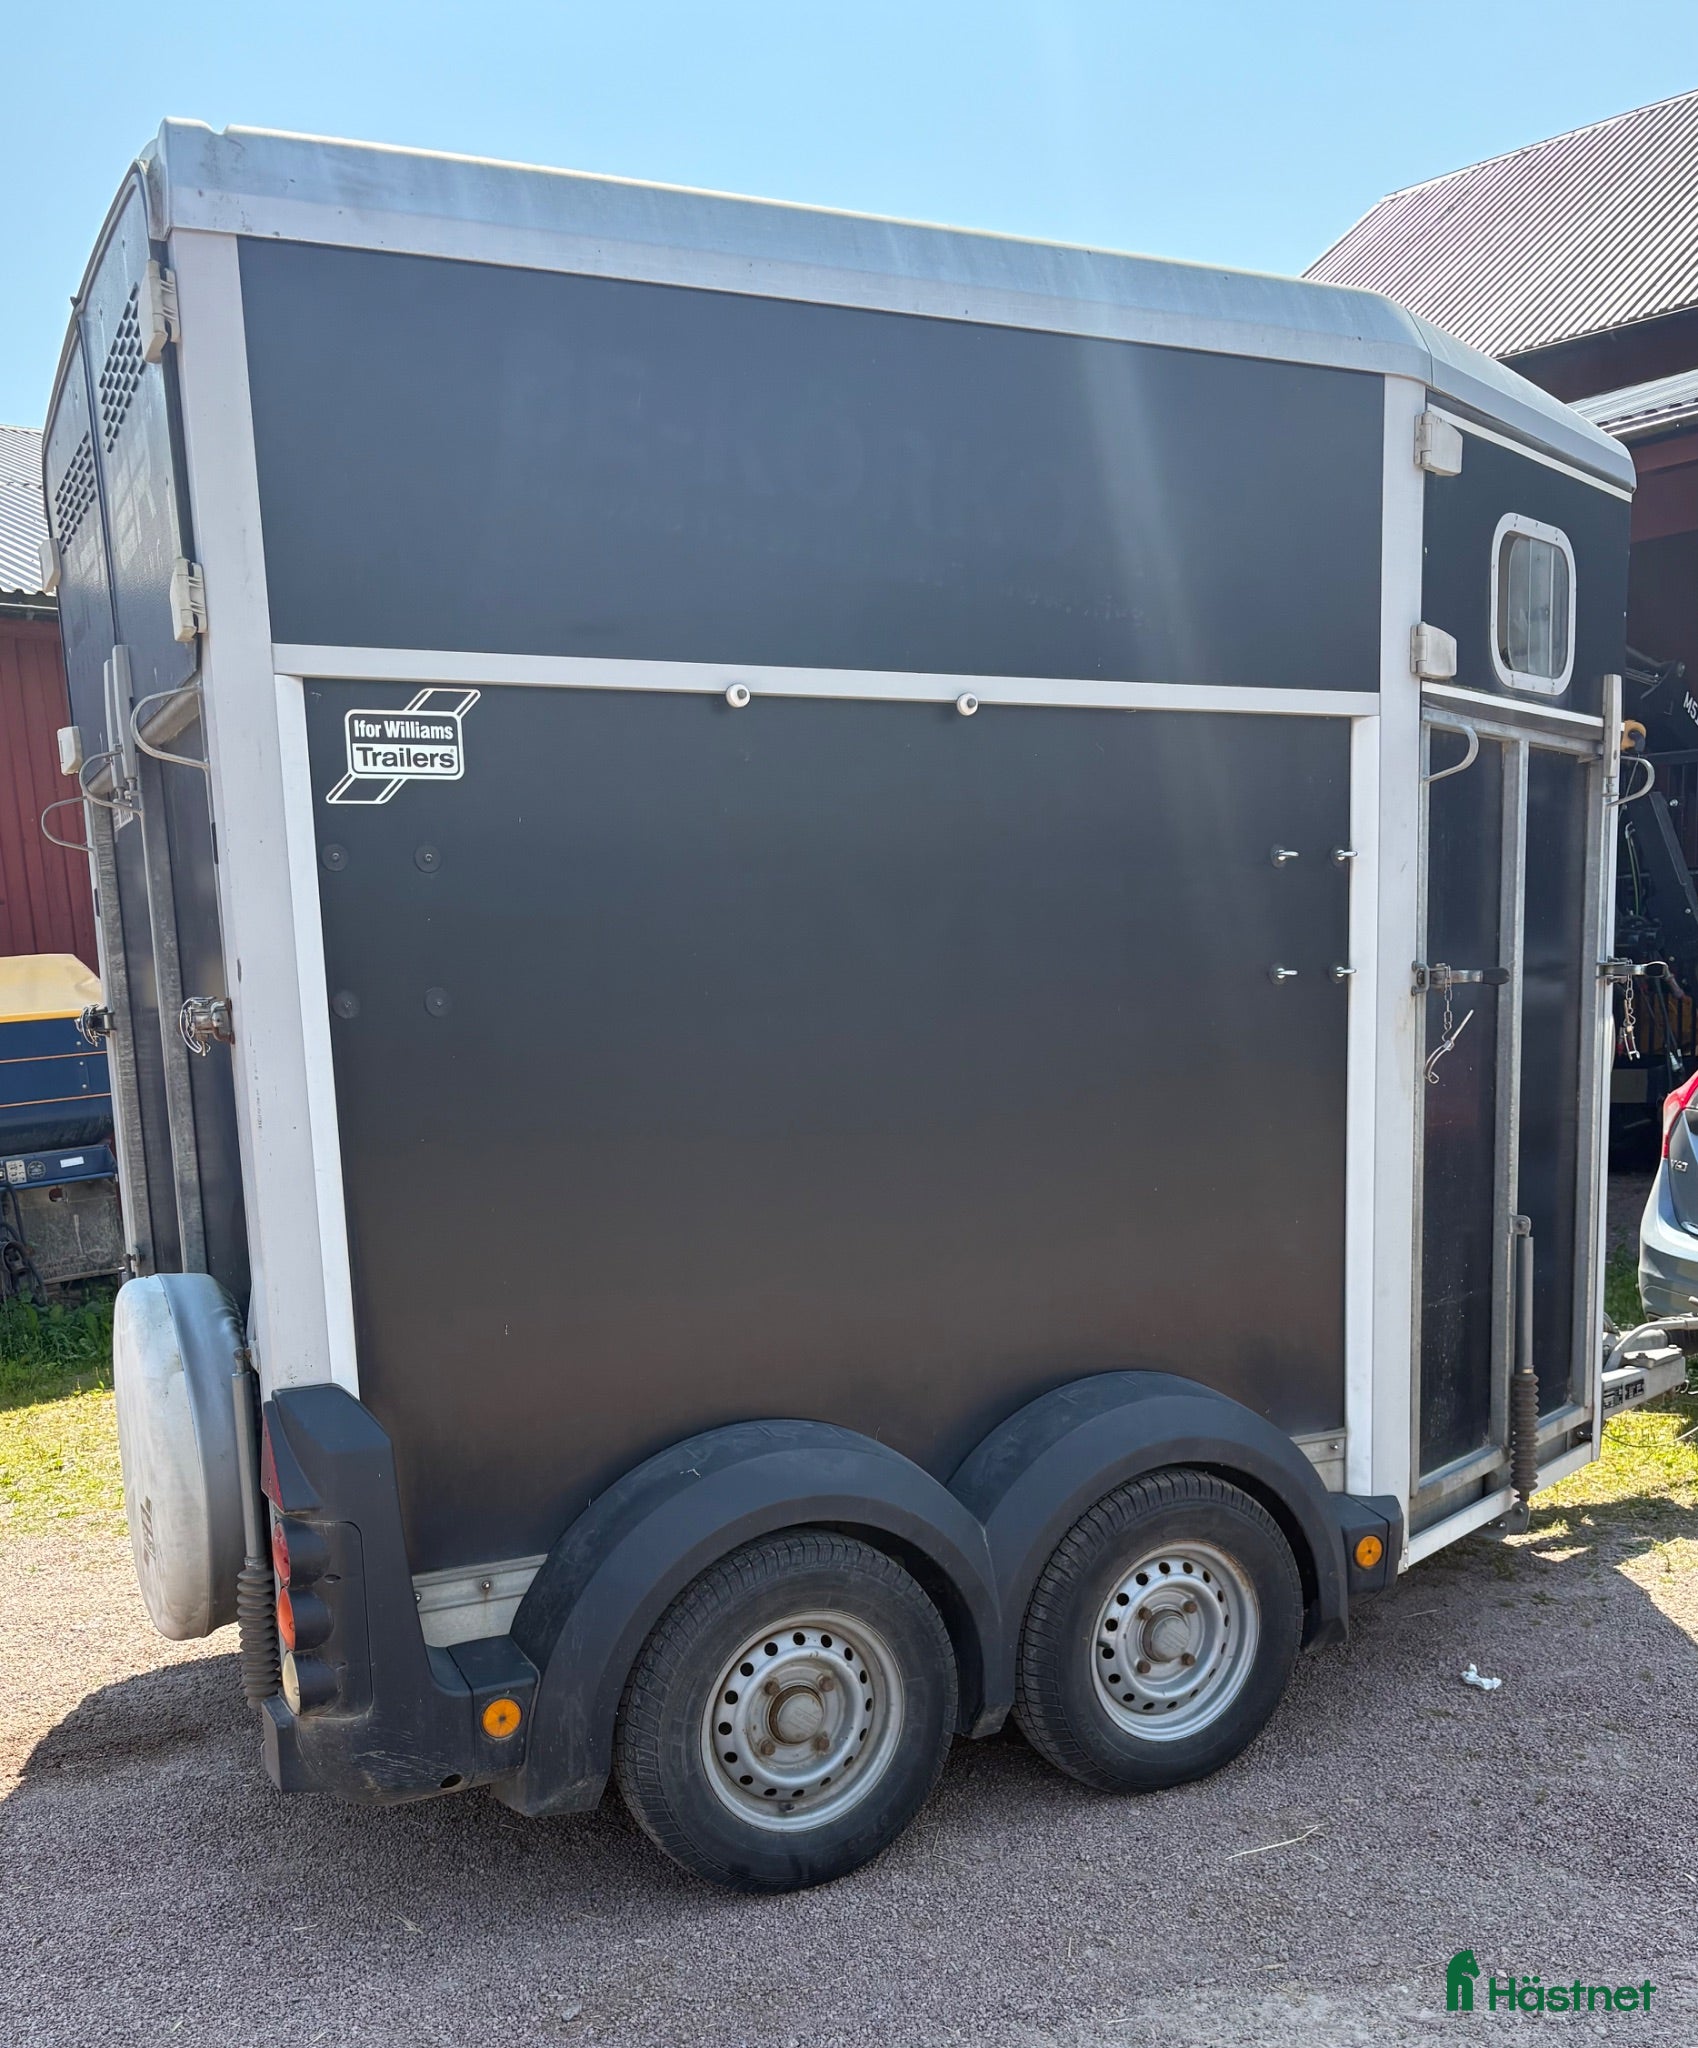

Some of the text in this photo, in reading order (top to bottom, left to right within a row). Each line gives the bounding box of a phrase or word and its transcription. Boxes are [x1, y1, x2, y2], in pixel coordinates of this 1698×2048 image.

[354, 719, 454, 740] Ifor Williams
[355, 747, 455, 769] Trailers
